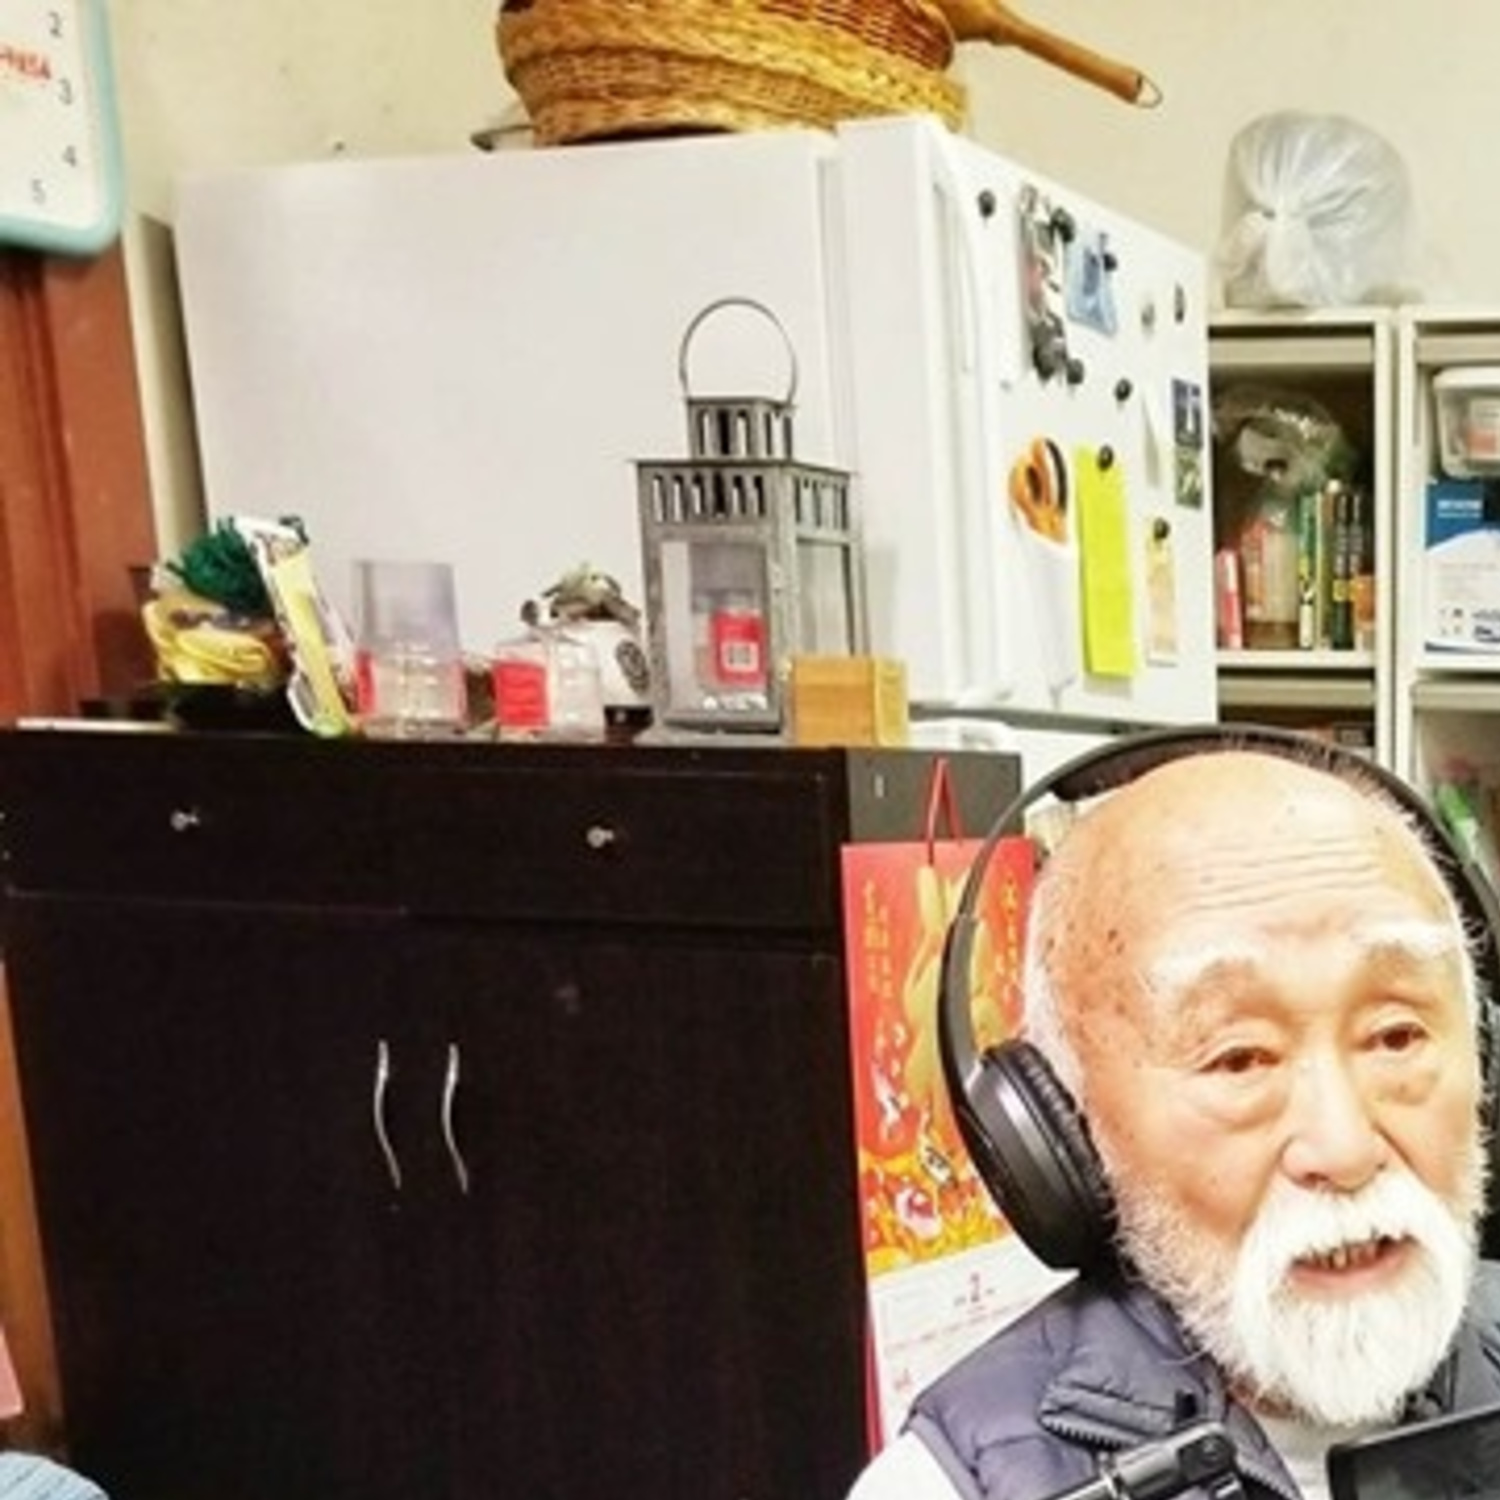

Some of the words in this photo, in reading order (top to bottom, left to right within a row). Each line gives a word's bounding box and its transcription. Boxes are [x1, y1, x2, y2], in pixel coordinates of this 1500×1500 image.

[48, 11, 63, 38] 2
[58, 77, 73, 106] 3
[62, 145, 77, 168] 4
[31, 178, 46, 204] 5
